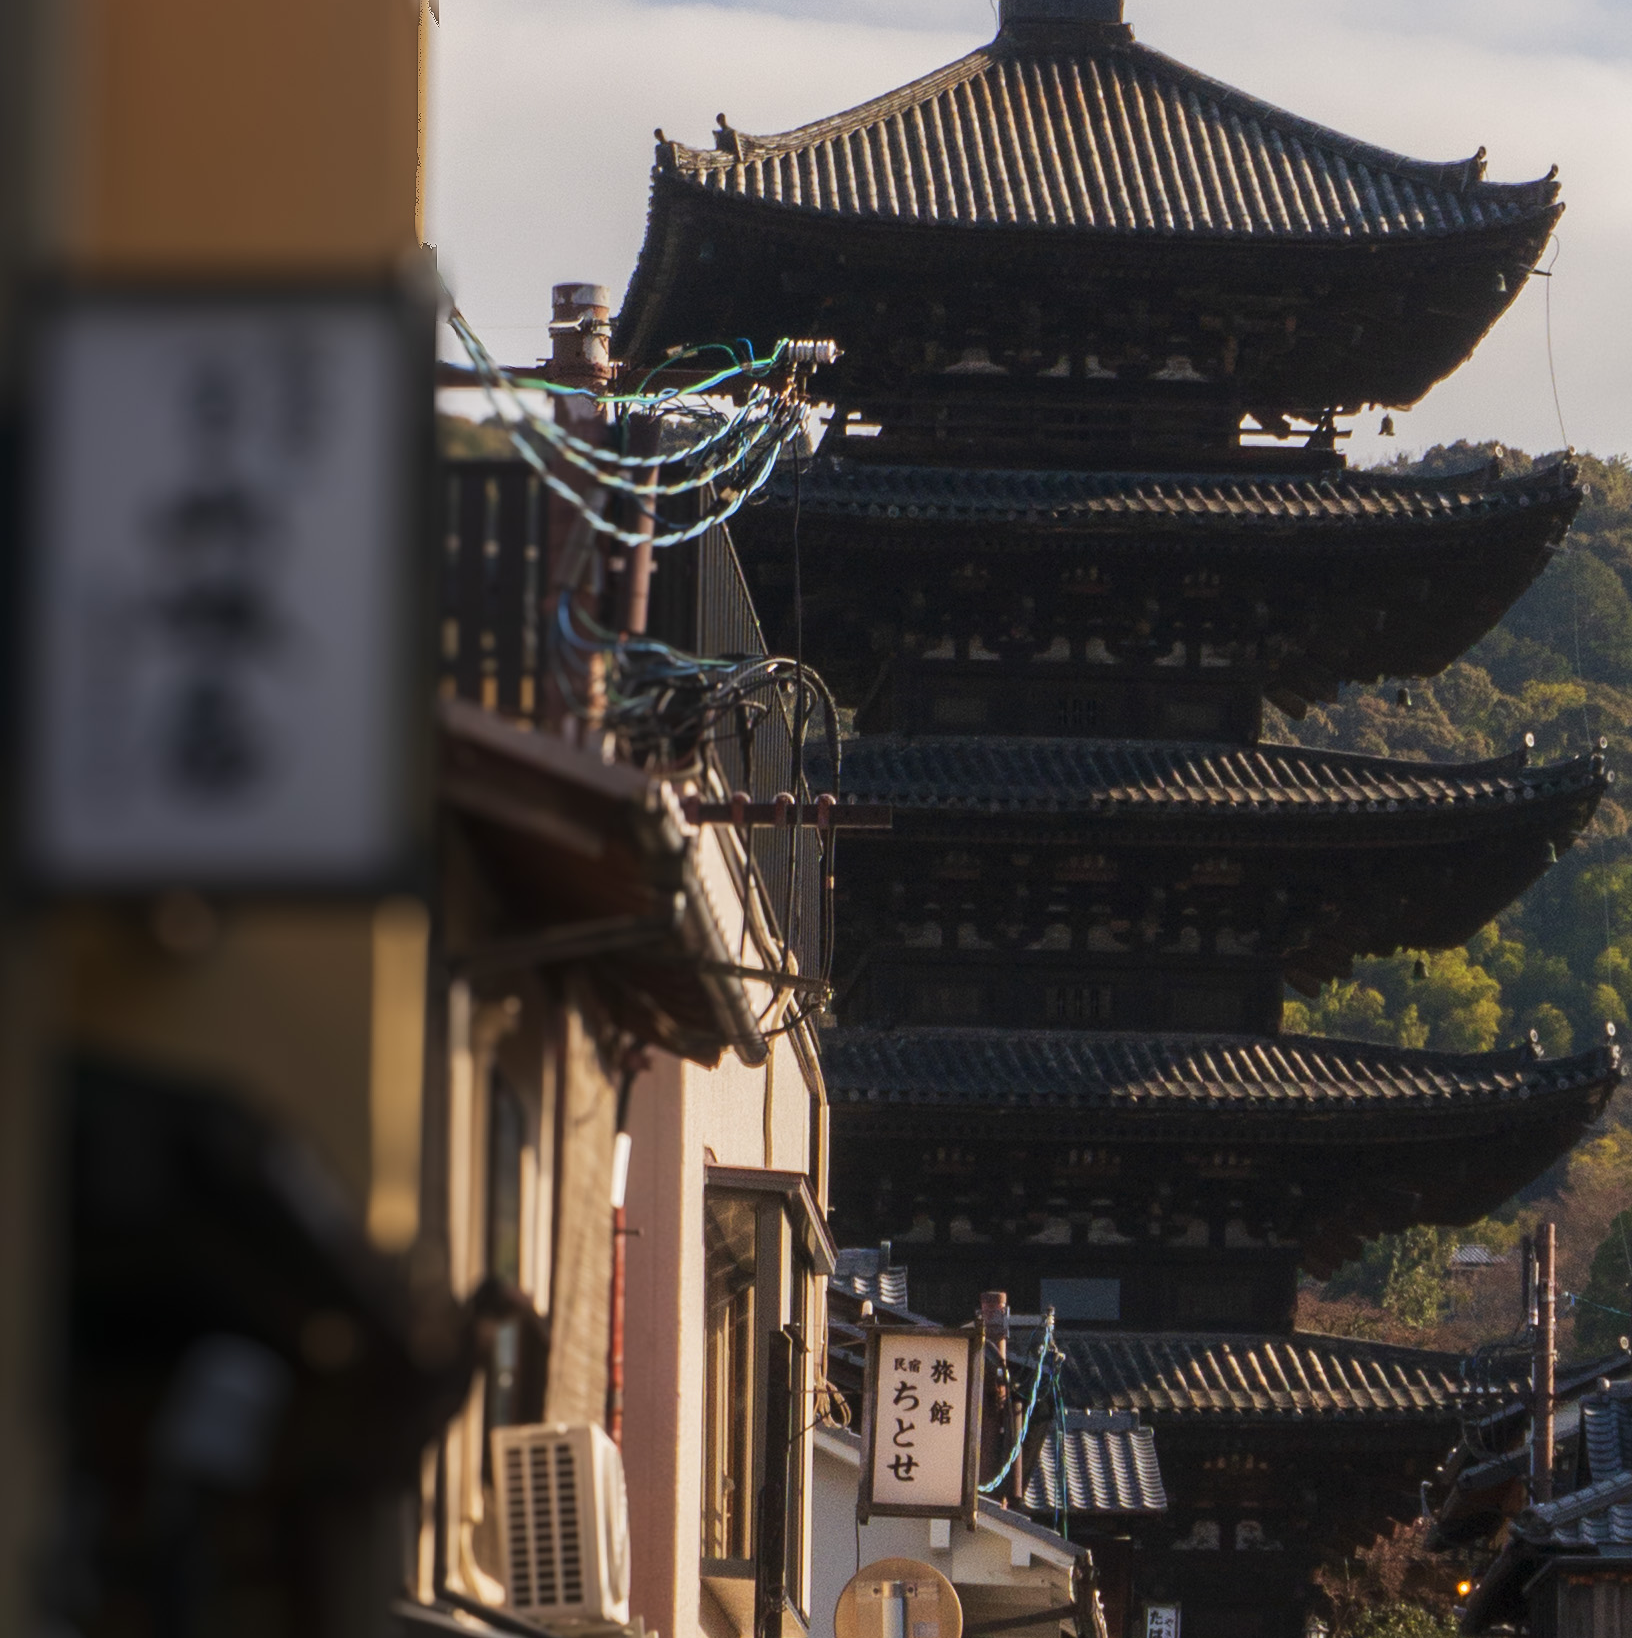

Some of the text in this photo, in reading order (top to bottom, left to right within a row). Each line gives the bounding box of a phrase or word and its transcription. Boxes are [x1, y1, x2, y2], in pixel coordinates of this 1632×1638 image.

[894, 1357, 921, 1374] 民宿
[930, 1359, 958, 1426] 旅館
[886, 1380, 920, 1482] ちとせ
